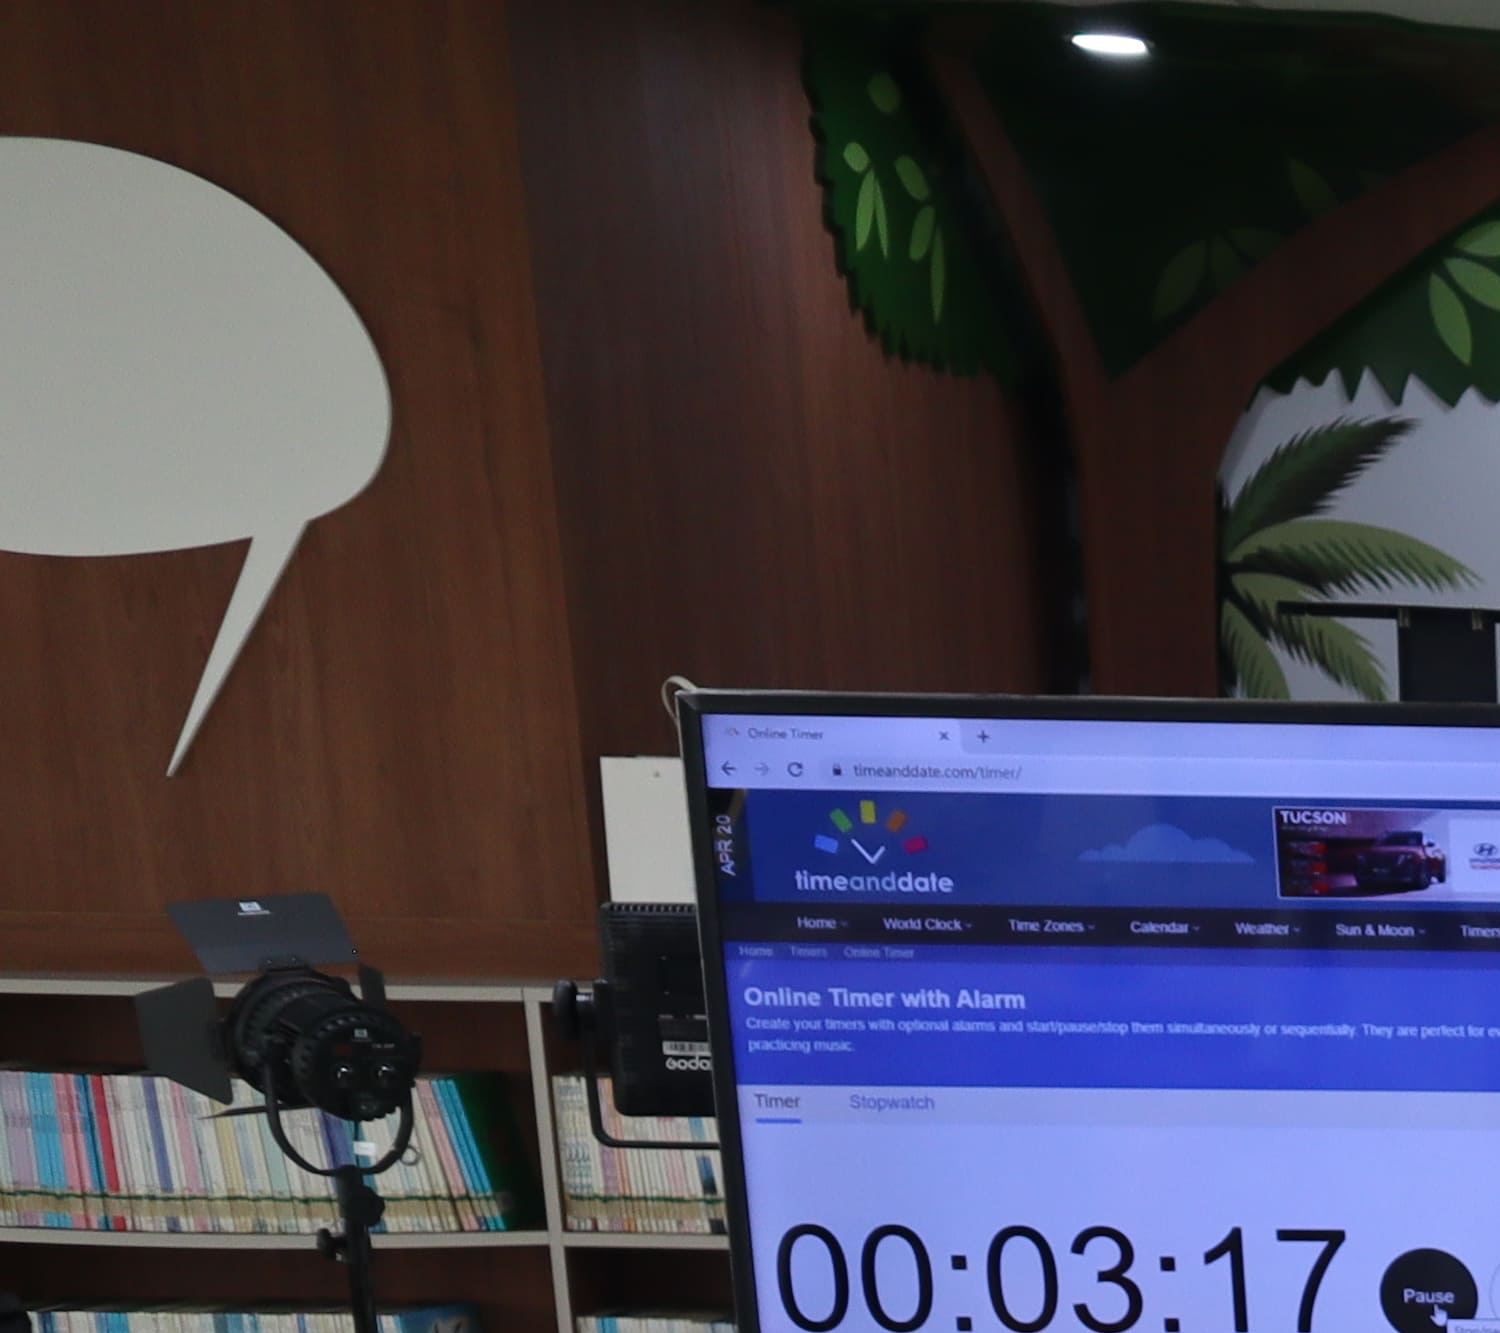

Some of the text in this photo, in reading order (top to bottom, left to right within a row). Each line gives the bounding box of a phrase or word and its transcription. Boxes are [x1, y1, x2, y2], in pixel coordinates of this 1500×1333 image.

[748, 728, 824, 741] Online Timer
[853, 763, 1023, 780] timeanddate.com/timer/
[1280, 811, 1347, 825] TUCSON
[717, 814, 736, 876] APR 20
[795, 870, 954, 893] timeanddate
[797, 916, 836, 930] Home
[884, 917, 961, 931] World Clock
[1009, 919, 1083, 933] Time Zones
[1131, 920, 1189, 934] Calendar
[1235, 921, 1289, 936] Weather
[1336, 923, 1414, 937] Sun Moon
[744, 987, 1026, 1010] Online Timer with Alarm
[746, 1016, 790, 1031] Create
[793, 1018, 823, 1033] your
[825, 1017, 866, 1032] timers
[869, 1018, 895, 1031] with
[898, 1018, 949, 1034] optional
[952, 1019, 995, 1032] alarms
[999, 1020, 1023, 1033] and
[1131, 1021, 1163, 1034] them
[1167, 1021, 1260, 1038] simultaneously
[1264, 1026, 1277, 1035] or
[1362, 1024, 1393, 1039] They
[1397, 1027, 1418, 1038] are
[1420, 1024, 1464, 1041] perfect
[1468, 1025, 1485, 1038] for
[748, 1038, 856, 1054] practicing music.
[755, 1094, 800, 1110] Timer
[849, 1094, 935, 1113] Stopwatch
[1403, 1288, 1454, 1304] Pause
